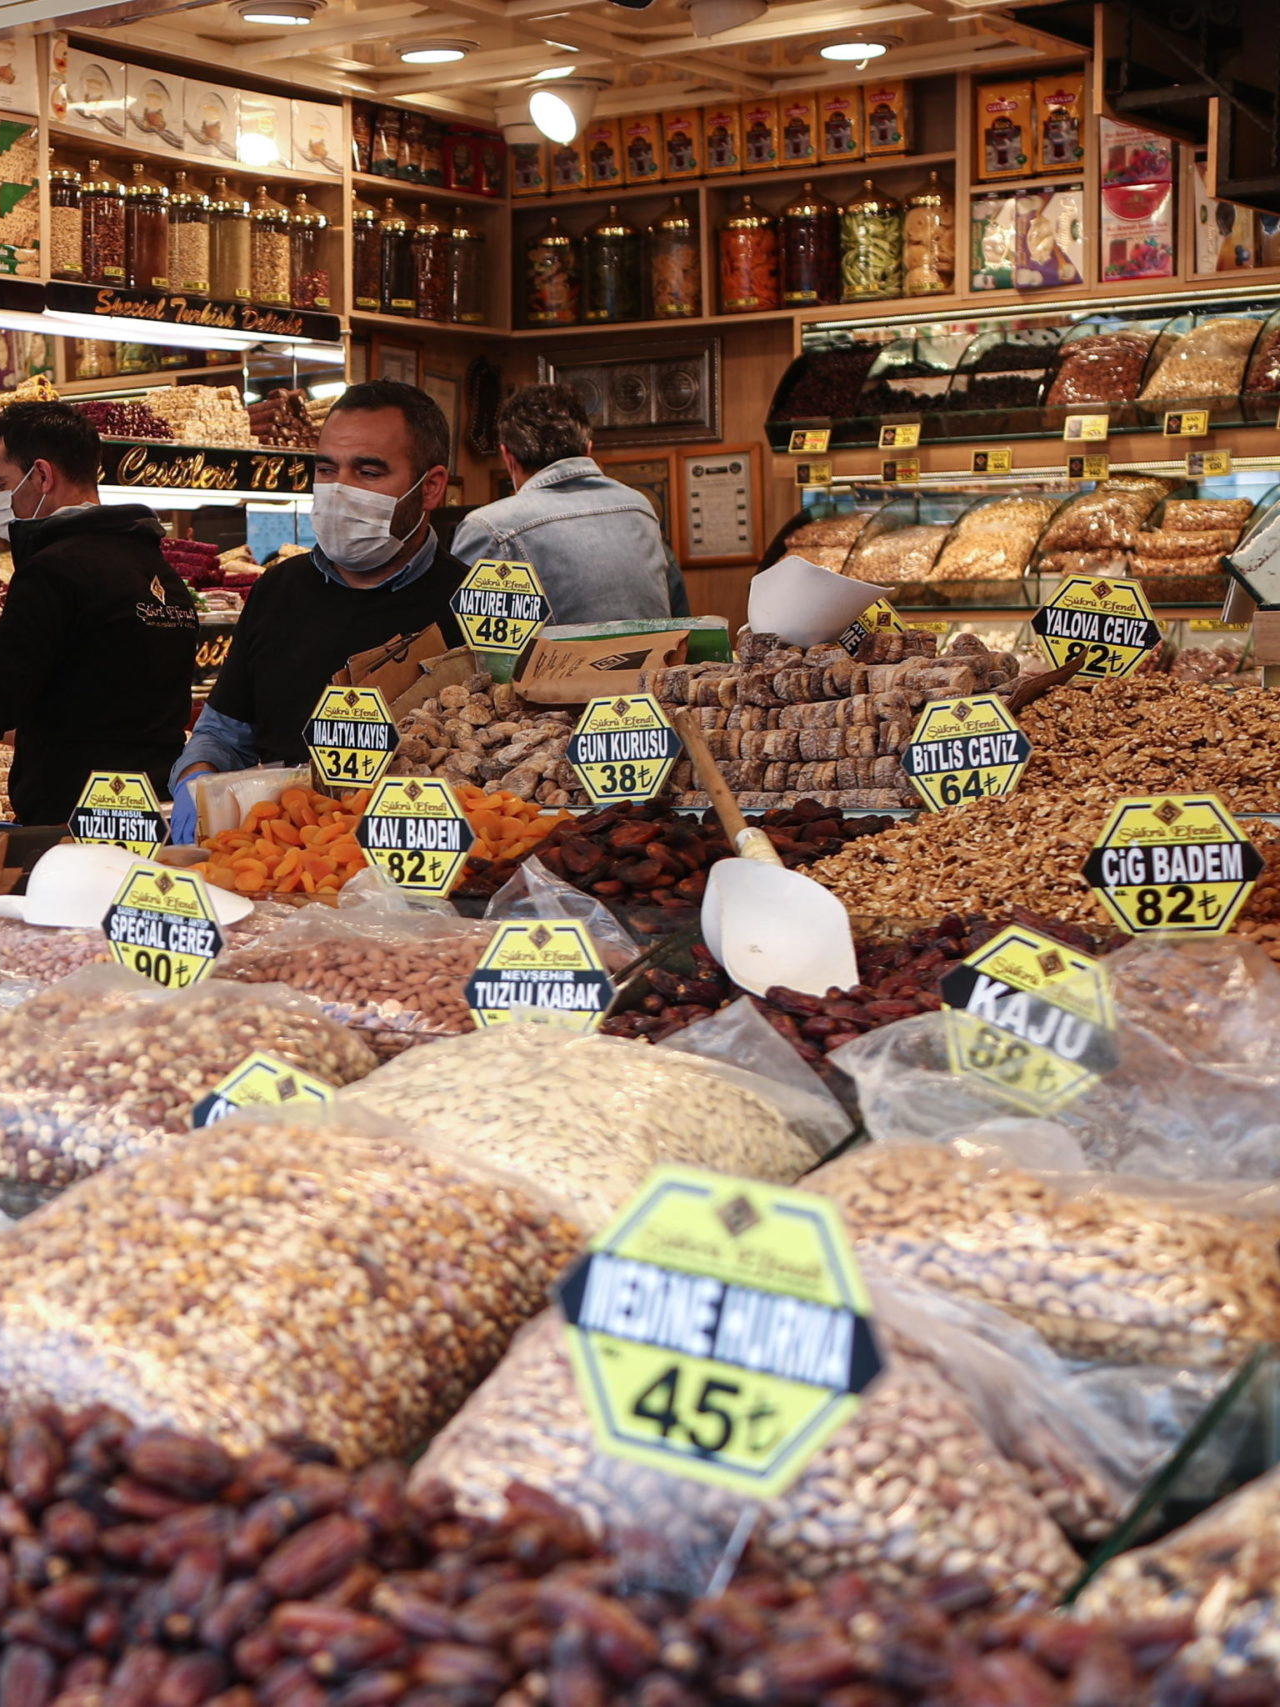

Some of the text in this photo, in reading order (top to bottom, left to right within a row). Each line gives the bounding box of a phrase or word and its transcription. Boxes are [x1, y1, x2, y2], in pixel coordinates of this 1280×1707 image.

[95, 289, 303, 335] Special Turkish Delight
[459, 590, 508, 617] NATUREL
[1062, 595, 1137, 612] Şükrü Efendi
[1046, 608, 1099, 640] YALOVA
[313, 720, 389, 749] MALATYA KAYISI
[589, 715, 654, 731] Şükrü Efendi
[927, 717, 1000, 739] Şükrü Efendi
[610, 730, 668, 760] KURUSU
[78, 815, 158, 842] TUZLU FISTIK
[368, 817, 460, 850] KAV. BADEM
[1117, 824, 1221, 844] Şükrü Efendi
[1152, 843, 1244, 884] BADEM
[474, 981, 602, 1010] TUZLU KABAK
[966, 973, 1094, 1060] KAJU
[714, 1284, 856, 1392] HURMA
